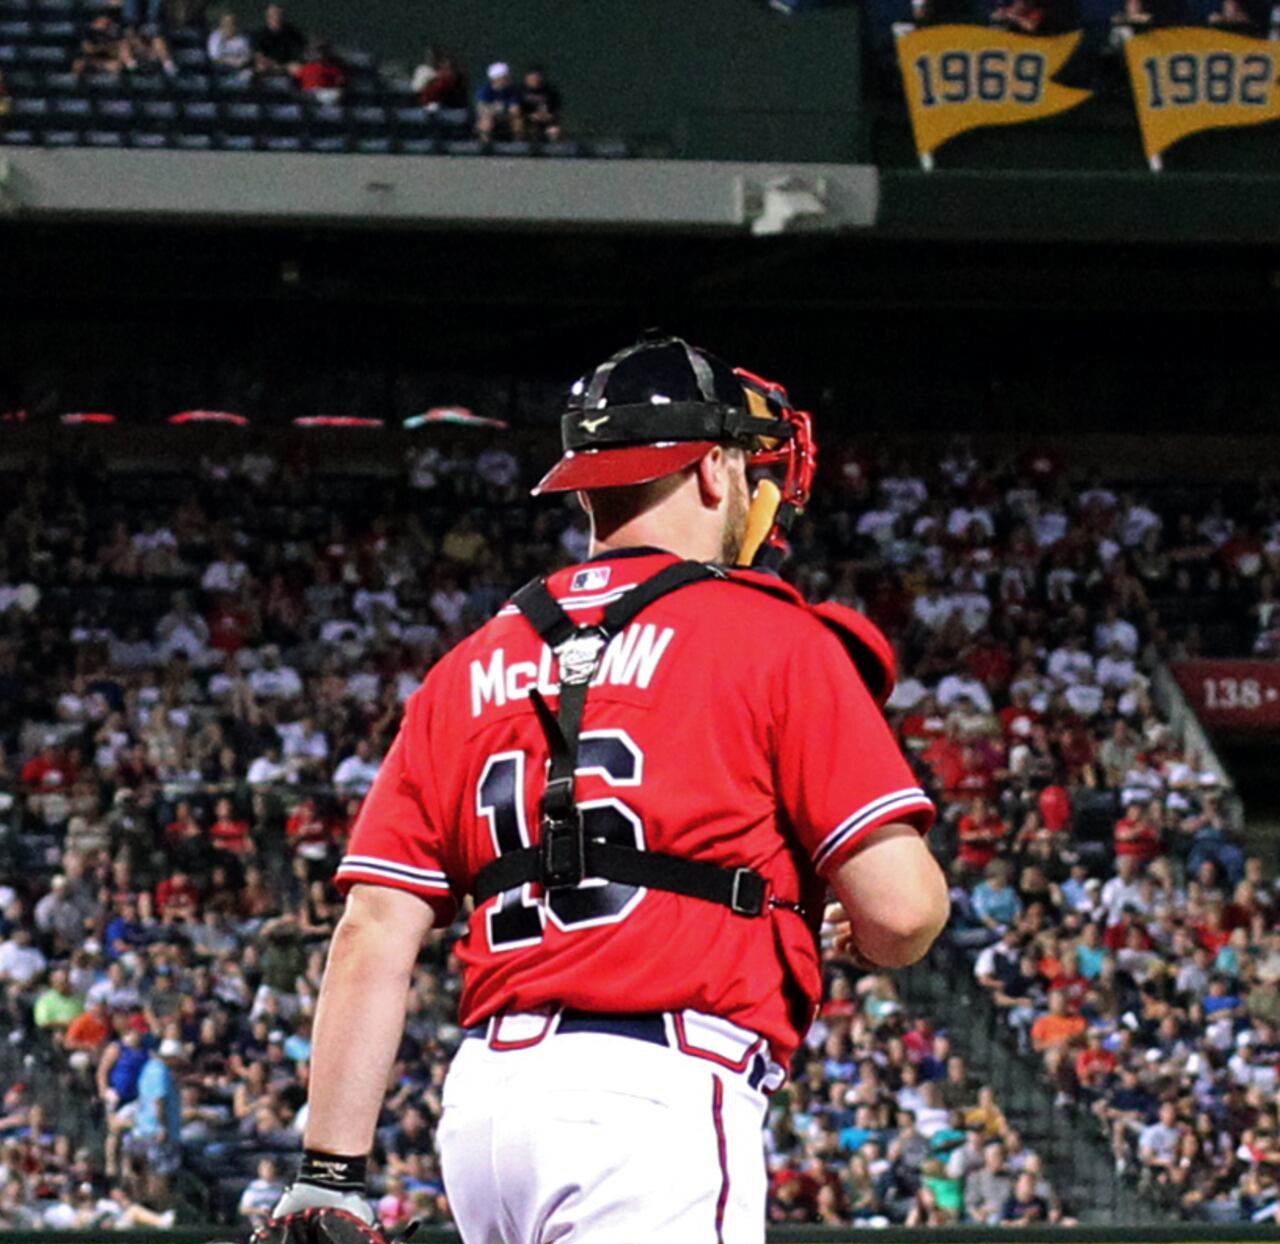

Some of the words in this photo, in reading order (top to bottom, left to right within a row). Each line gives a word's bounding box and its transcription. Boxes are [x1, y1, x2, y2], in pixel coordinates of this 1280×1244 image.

[915, 50, 1044, 107] 1969
[1143, 53, 1273, 109] 1982
[476, 728, 648, 952] 16
